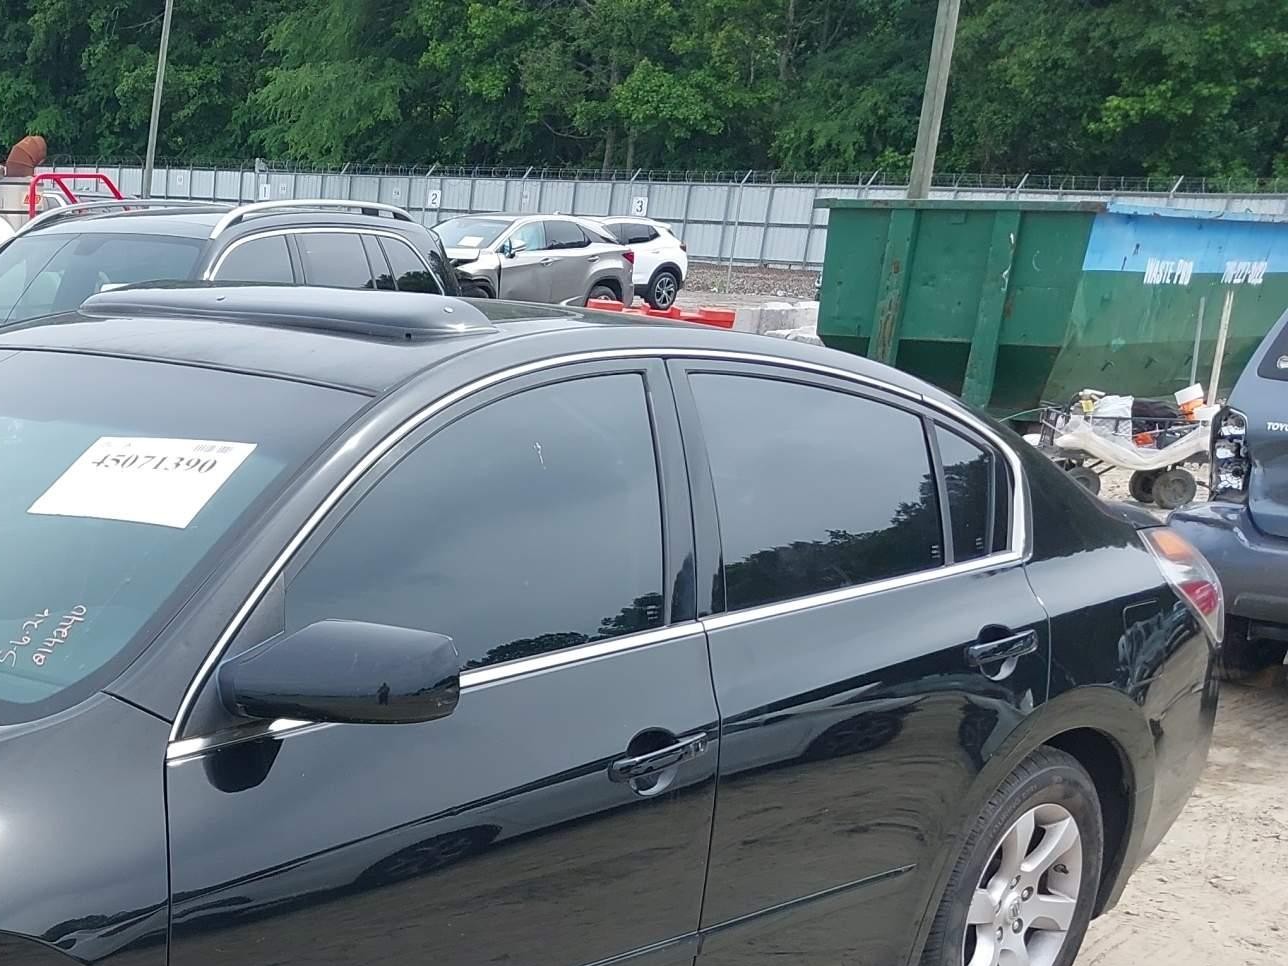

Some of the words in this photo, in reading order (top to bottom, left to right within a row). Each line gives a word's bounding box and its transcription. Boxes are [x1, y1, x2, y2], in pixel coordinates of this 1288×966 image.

[431, 192, 438, 205] 2
[635, 199, 644, 213] 3
[92, 453, 218, 474] 45071390
